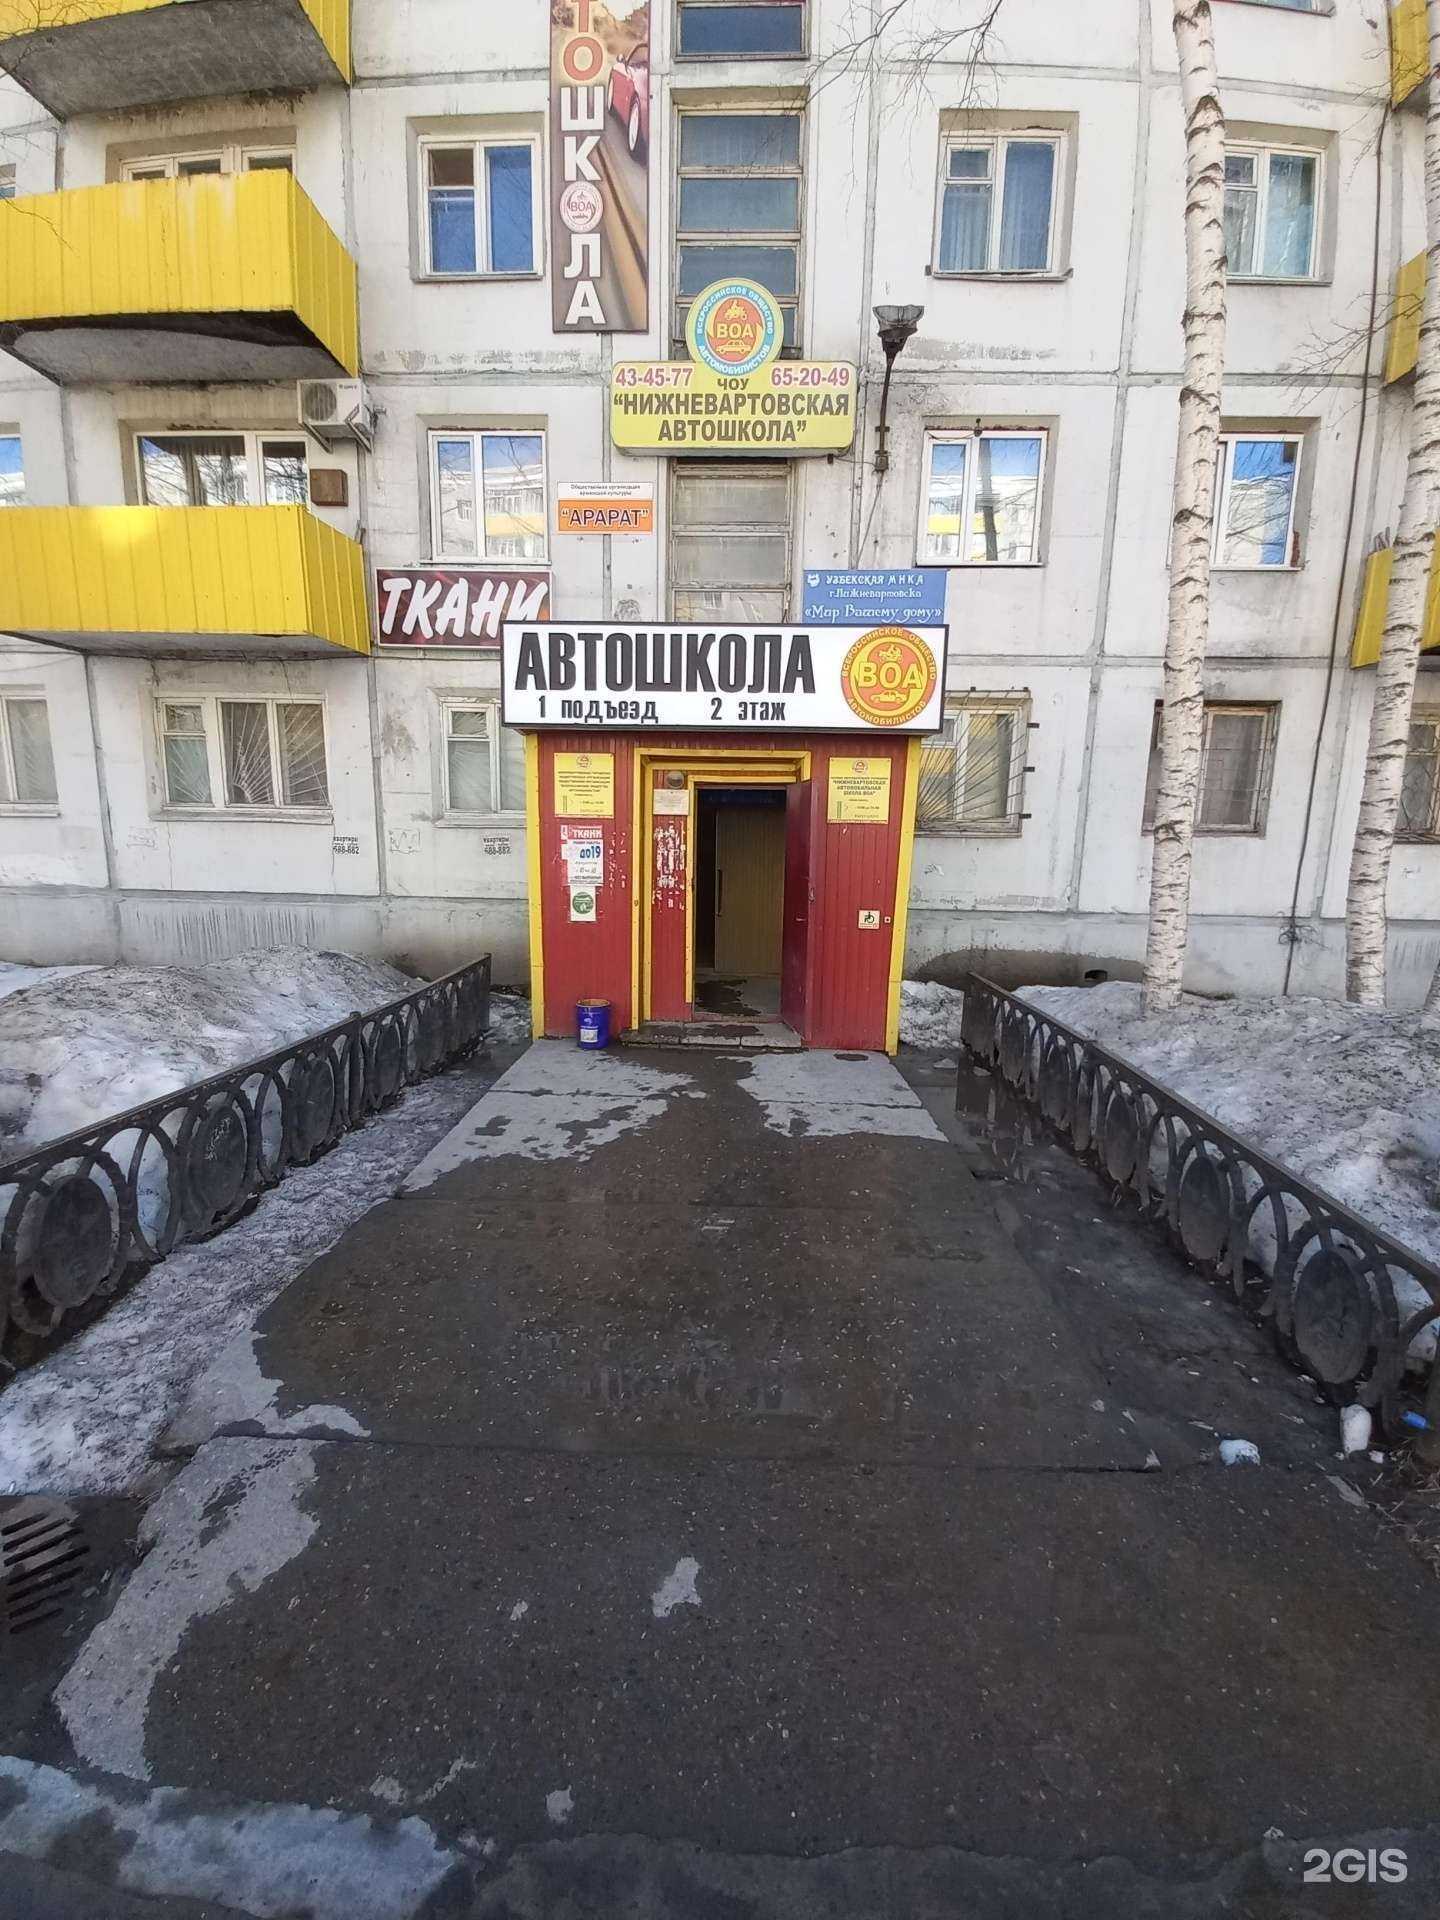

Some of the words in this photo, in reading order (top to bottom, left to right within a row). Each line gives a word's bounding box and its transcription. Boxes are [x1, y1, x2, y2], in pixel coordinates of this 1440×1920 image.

[716, 323, 754, 339] ВОА
[615, 367, 693, 387] 43-45-77
[717, 378, 749, 391] ЧОУ
[771, 367, 850, 387] 65-20-49
[382, 577, 549, 640] ТКАНИ
[514, 632, 817, 693] АВТОШКОЛА
[857, 661, 923, 690] ВОА
[538, 695, 547, 718] 1
[561, 699, 659, 723] подъезд
[710, 697, 722, 720] 2
[738, 702, 786, 720] этаж
